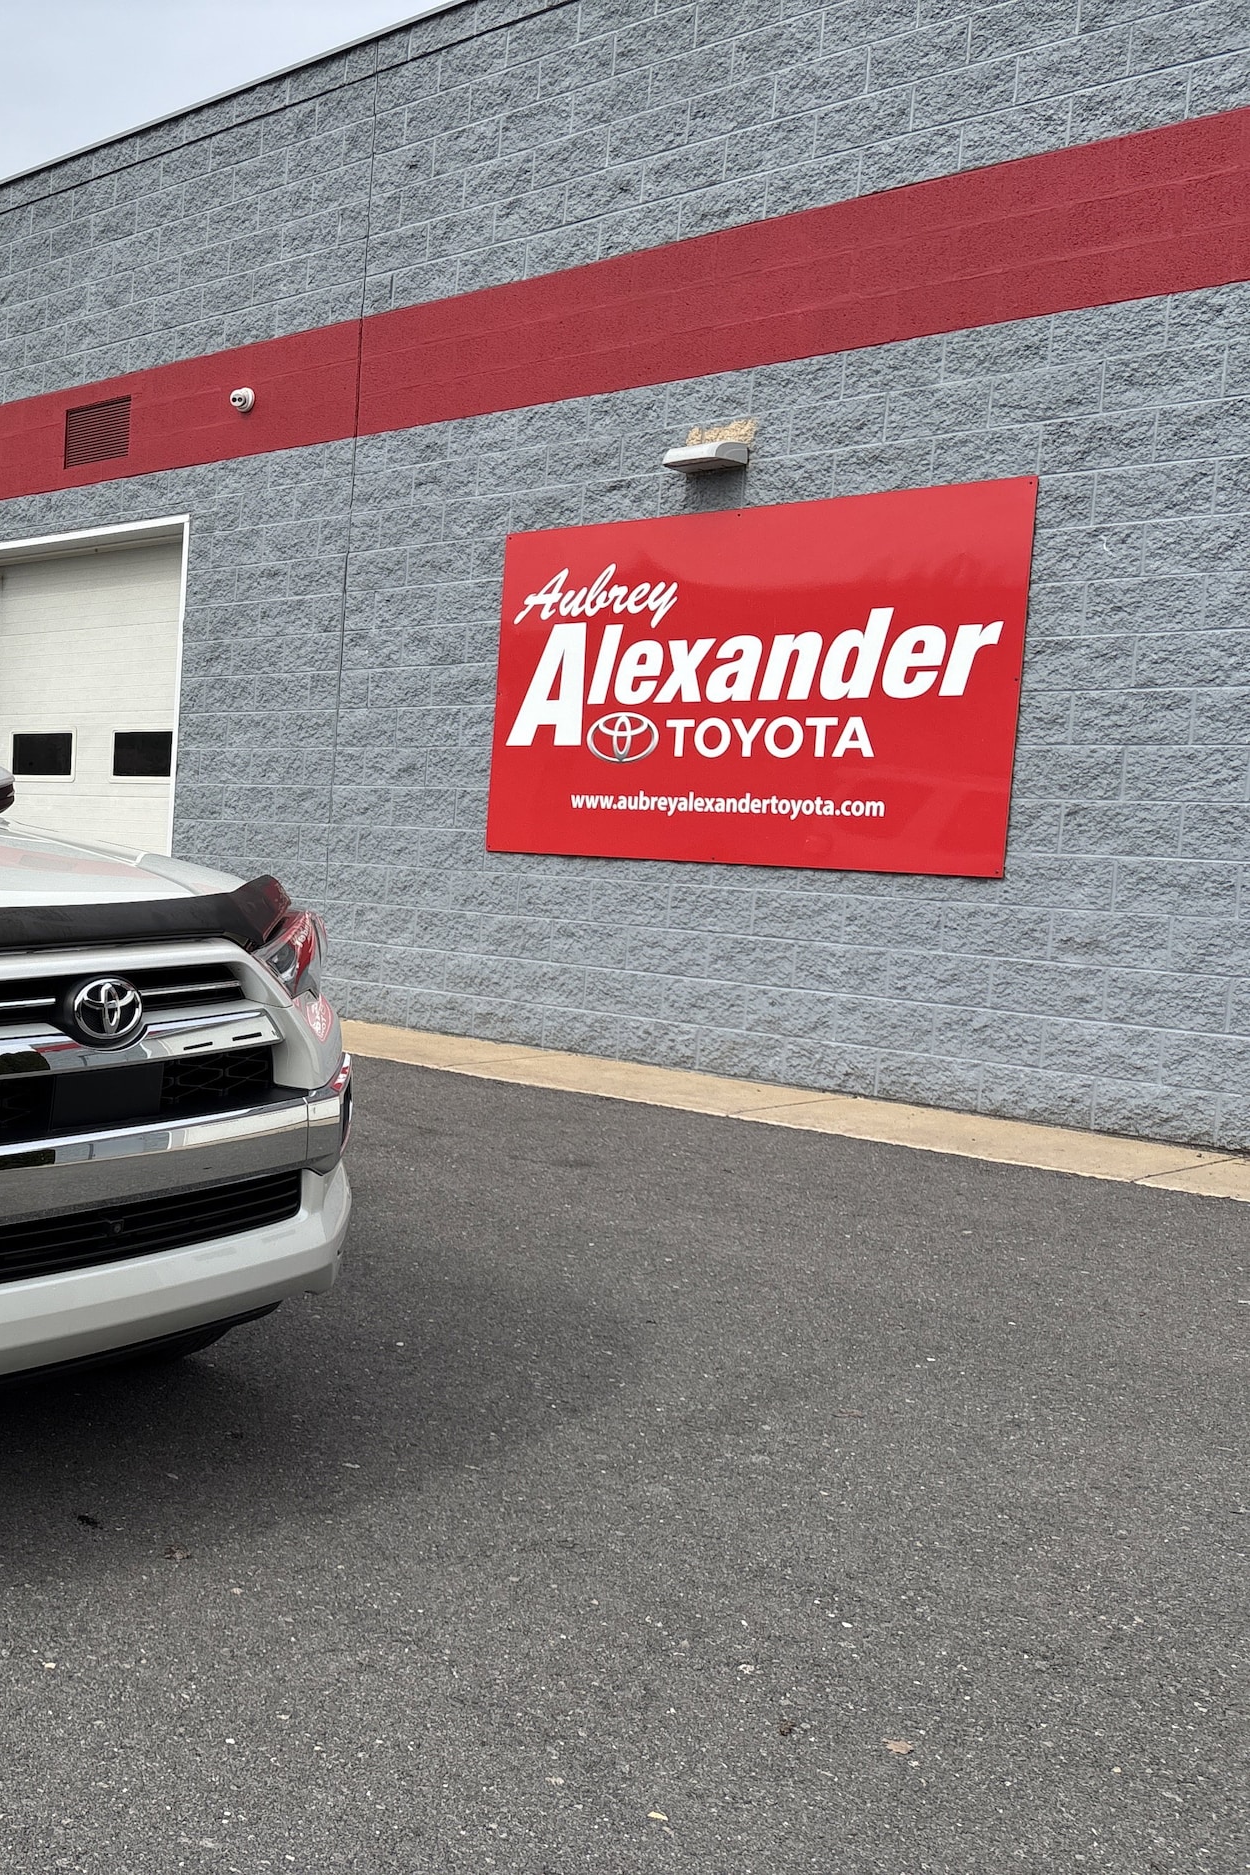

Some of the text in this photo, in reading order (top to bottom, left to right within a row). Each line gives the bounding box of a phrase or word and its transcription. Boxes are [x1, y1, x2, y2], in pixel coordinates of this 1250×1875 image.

[513, 563, 678, 629] Aubrey
[506, 607, 1004, 747] Alexander
[665, 716, 875, 759] TOYOTA
[570, 790, 885, 821] www.aubreyalexandertoyota.com
